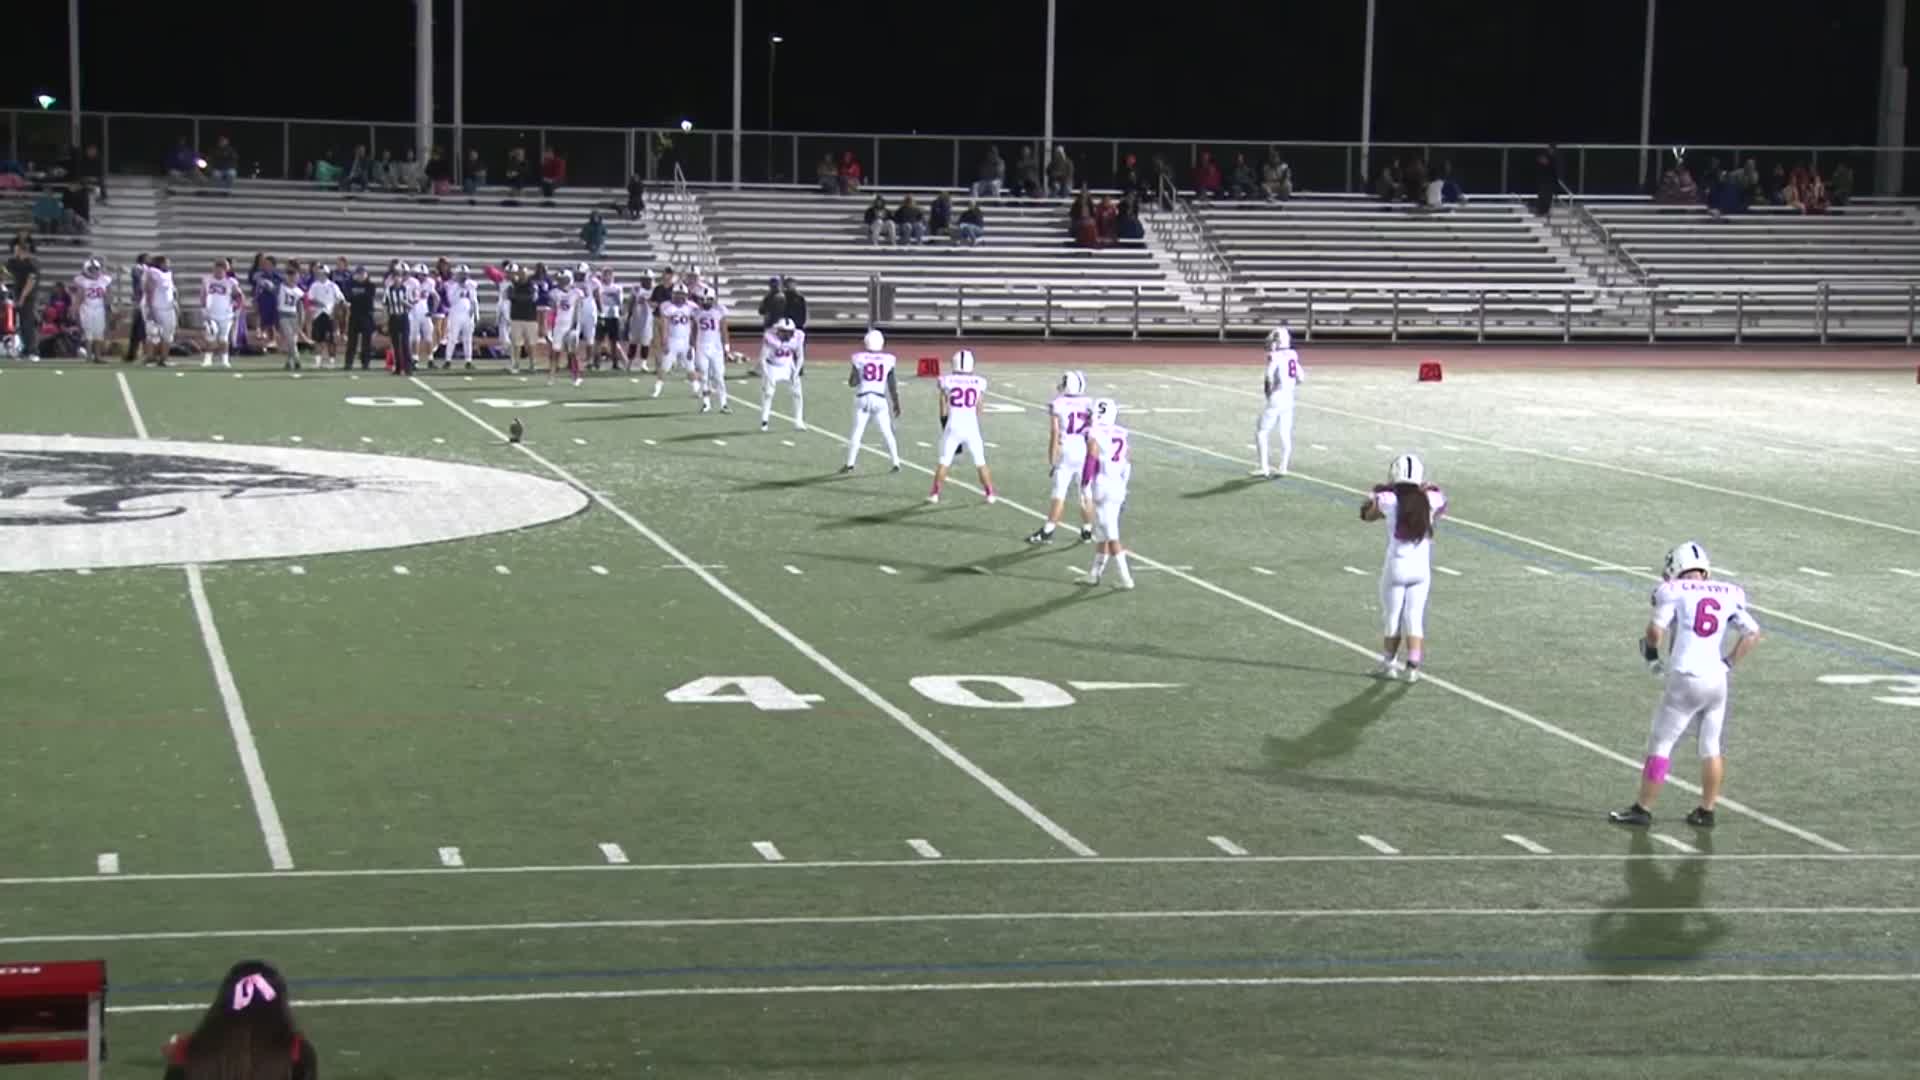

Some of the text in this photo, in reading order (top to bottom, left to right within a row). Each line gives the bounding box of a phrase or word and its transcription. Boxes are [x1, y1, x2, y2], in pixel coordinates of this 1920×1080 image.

[699, 317, 715, 331] 51
[863, 362, 884, 382] 81
[1288, 359, 1297, 378] 8
[949, 386, 977, 409] 20
[1111, 437, 1124, 462] 7
[1692, 597, 1721, 638] 6
[665, 675, 1076, 709] 40
